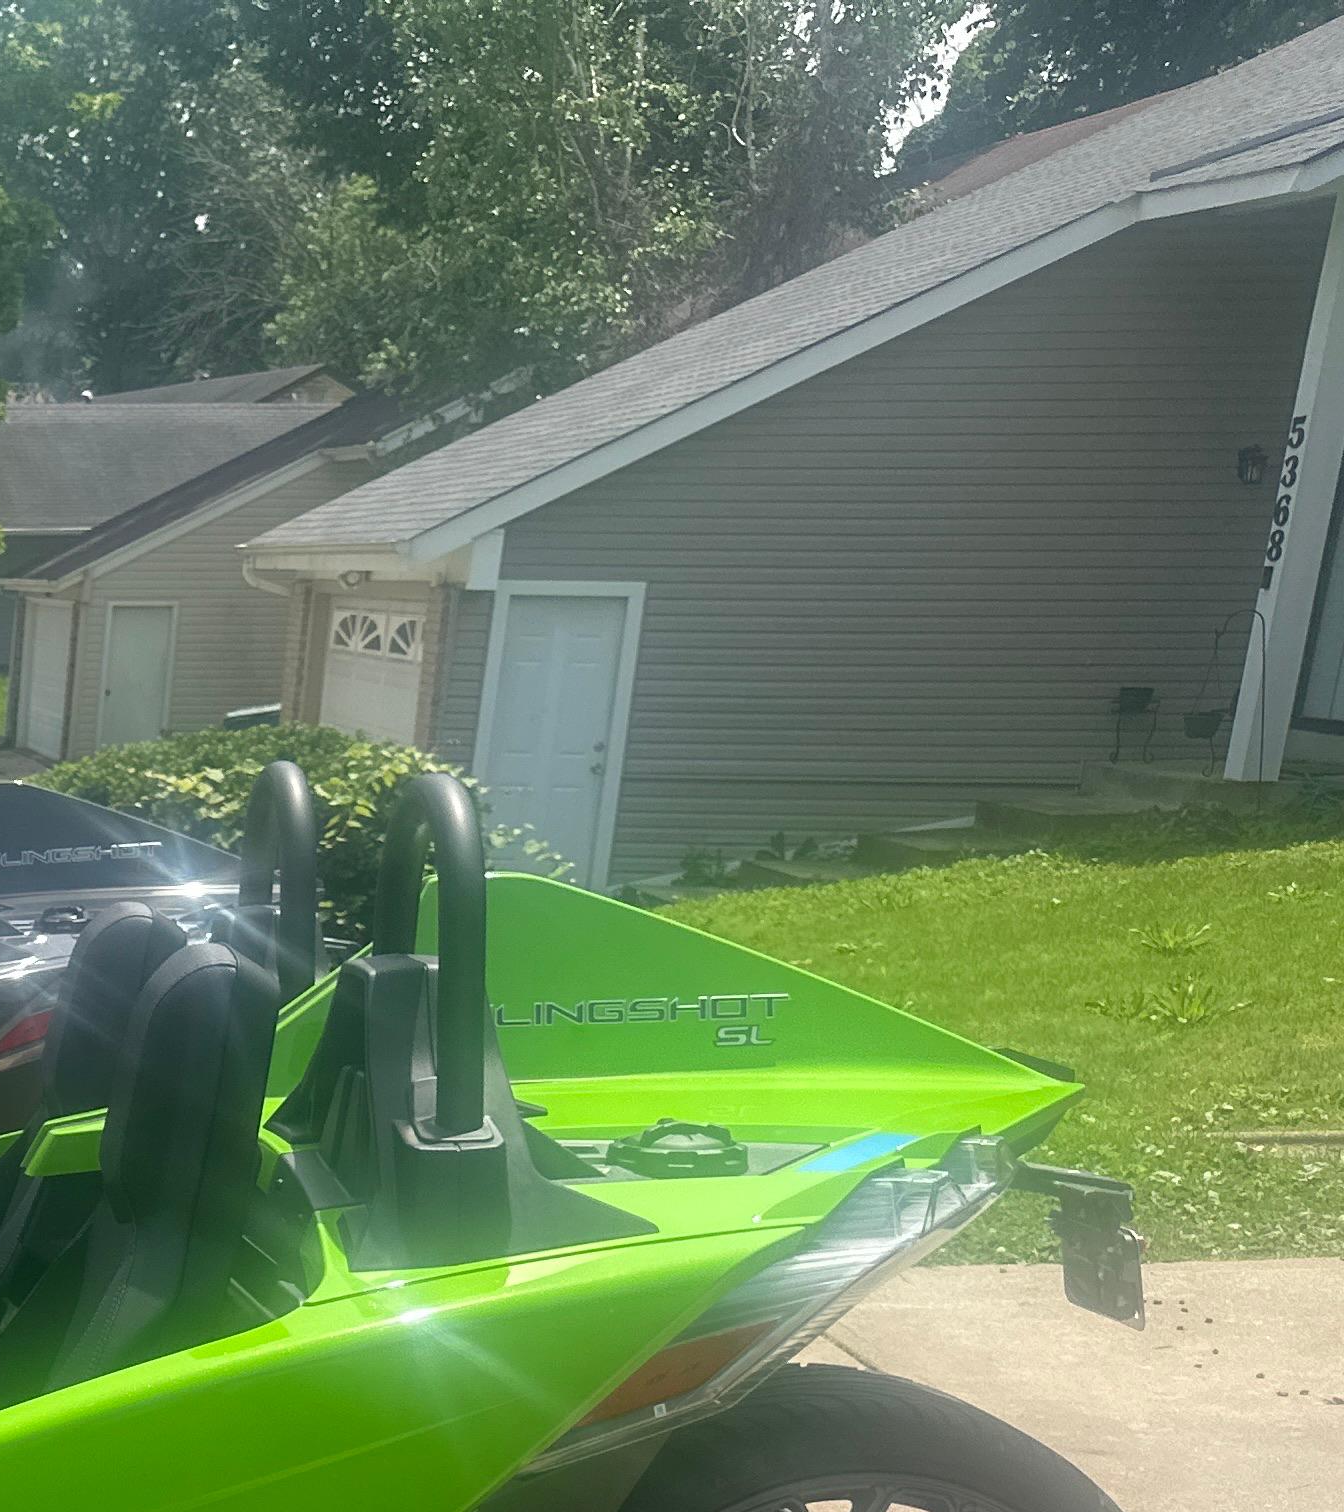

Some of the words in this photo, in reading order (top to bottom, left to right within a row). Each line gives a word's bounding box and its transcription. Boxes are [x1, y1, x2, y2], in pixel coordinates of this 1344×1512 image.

[1262, 415, 1307, 562] 5368
[489, 993, 790, 1027] LINGSHOT
[714, 1024, 773, 1047] SL
